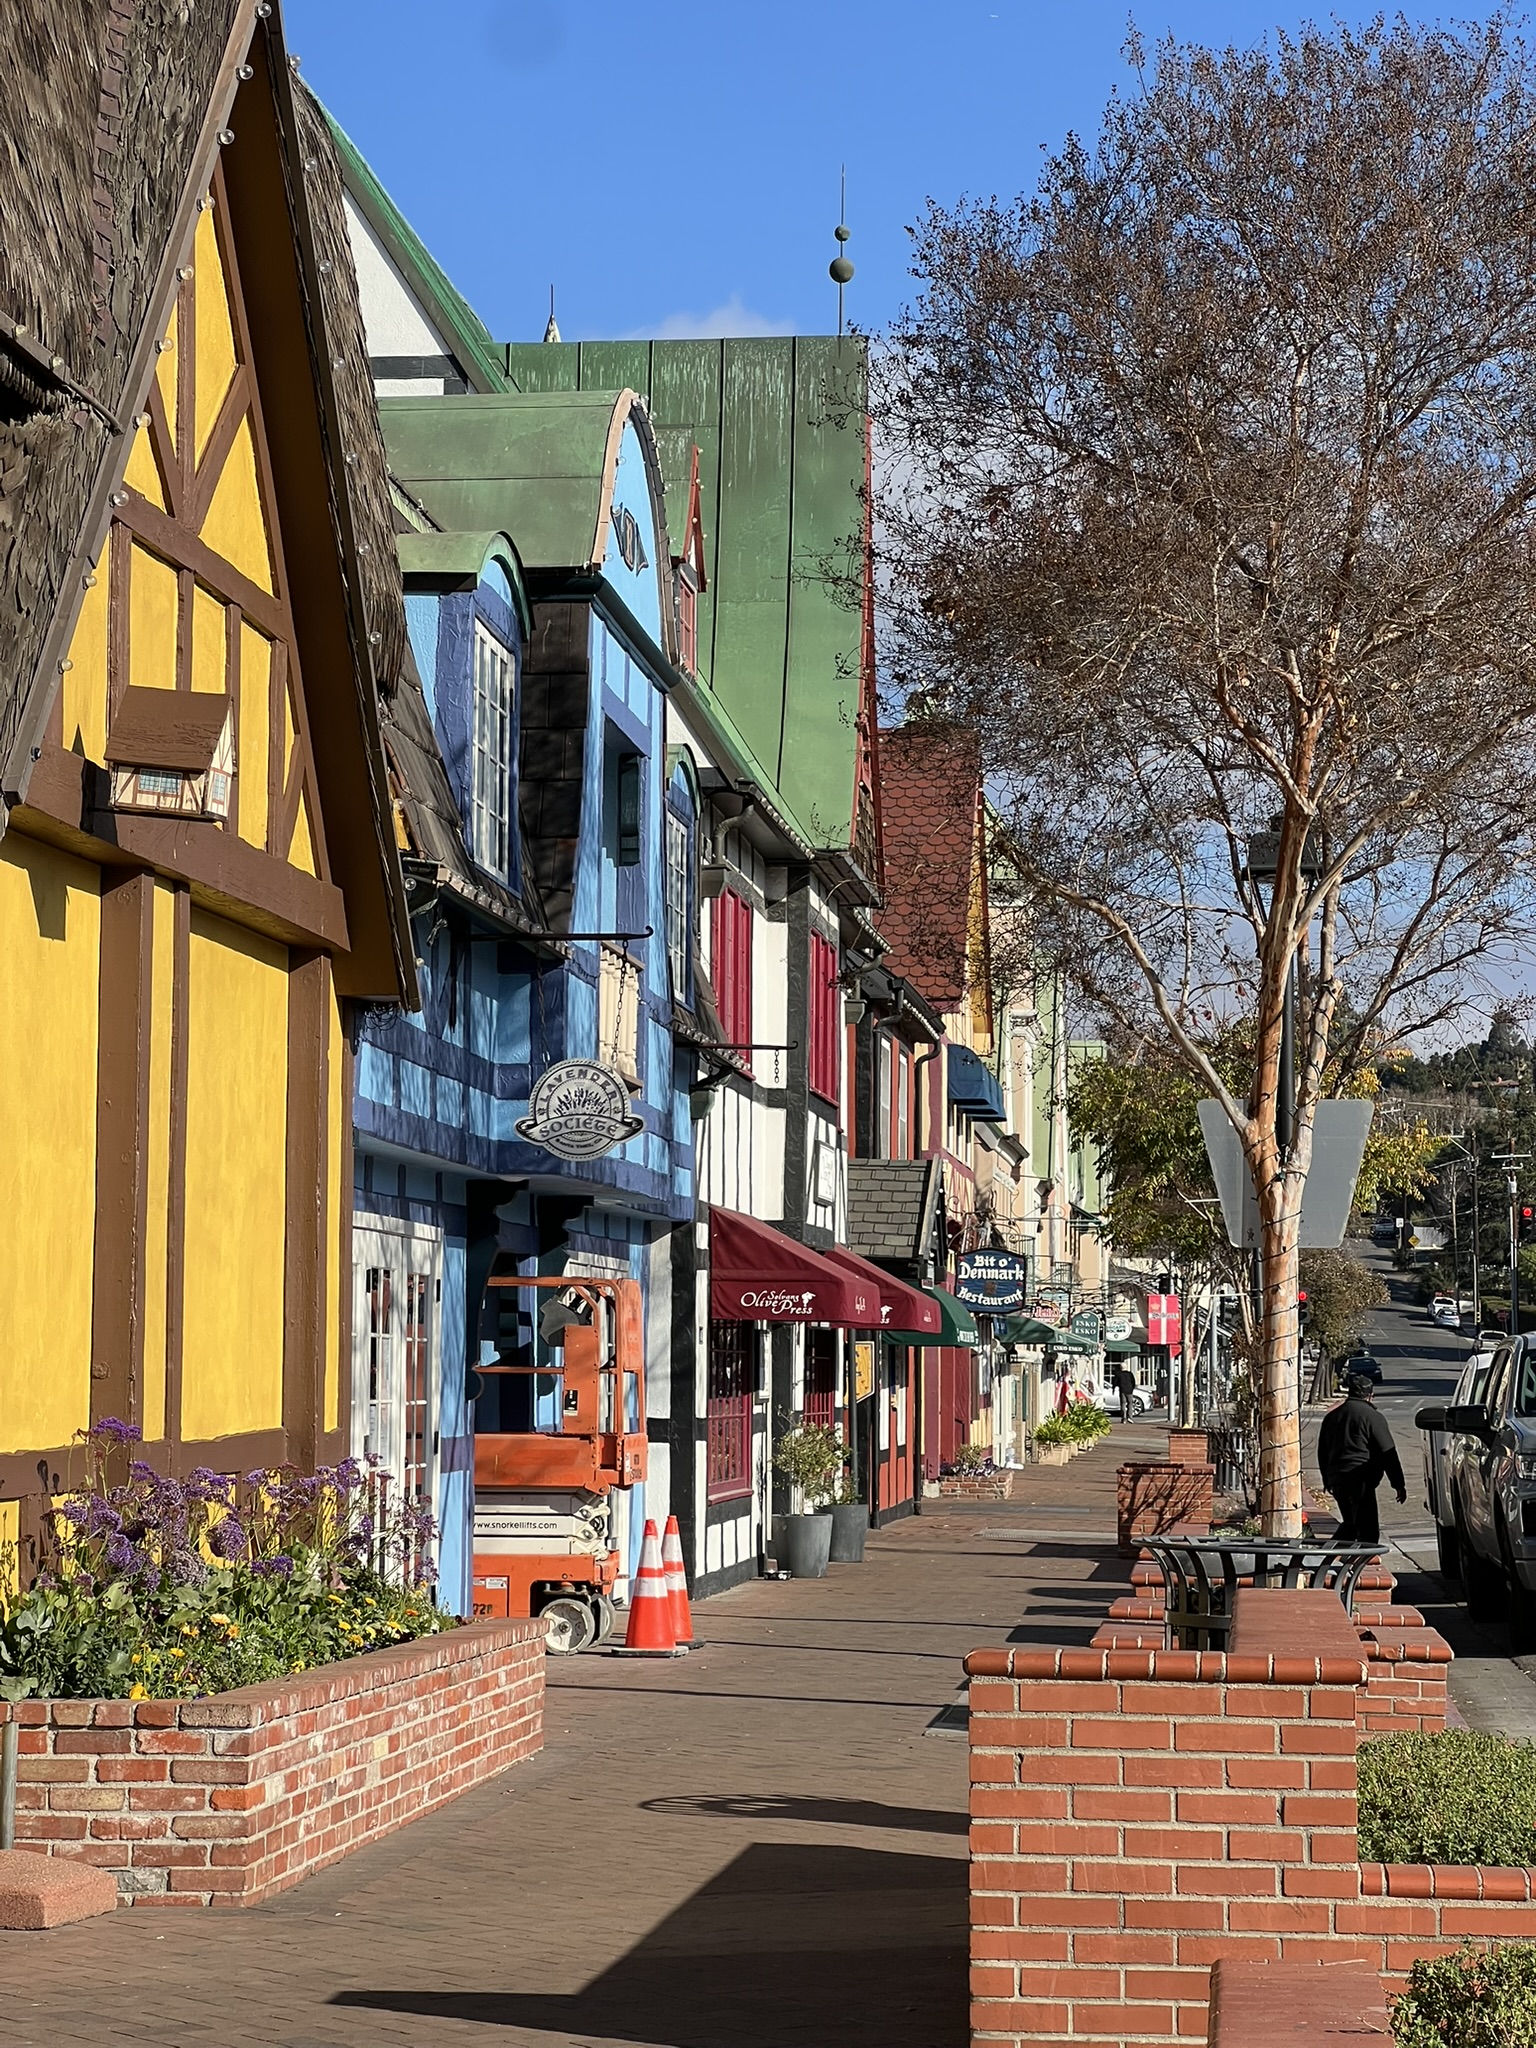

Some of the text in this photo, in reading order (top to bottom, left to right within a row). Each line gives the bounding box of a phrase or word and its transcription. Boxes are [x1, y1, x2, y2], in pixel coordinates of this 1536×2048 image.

[540, 1068, 618, 1102] LAVENDER
[973, 1254, 997, 1267] Bit
[957, 1261, 1025, 1281] Denmark
[740, 1290, 813, 1315] Olive Press
[956, 1286, 1024, 1306] Restaurant
